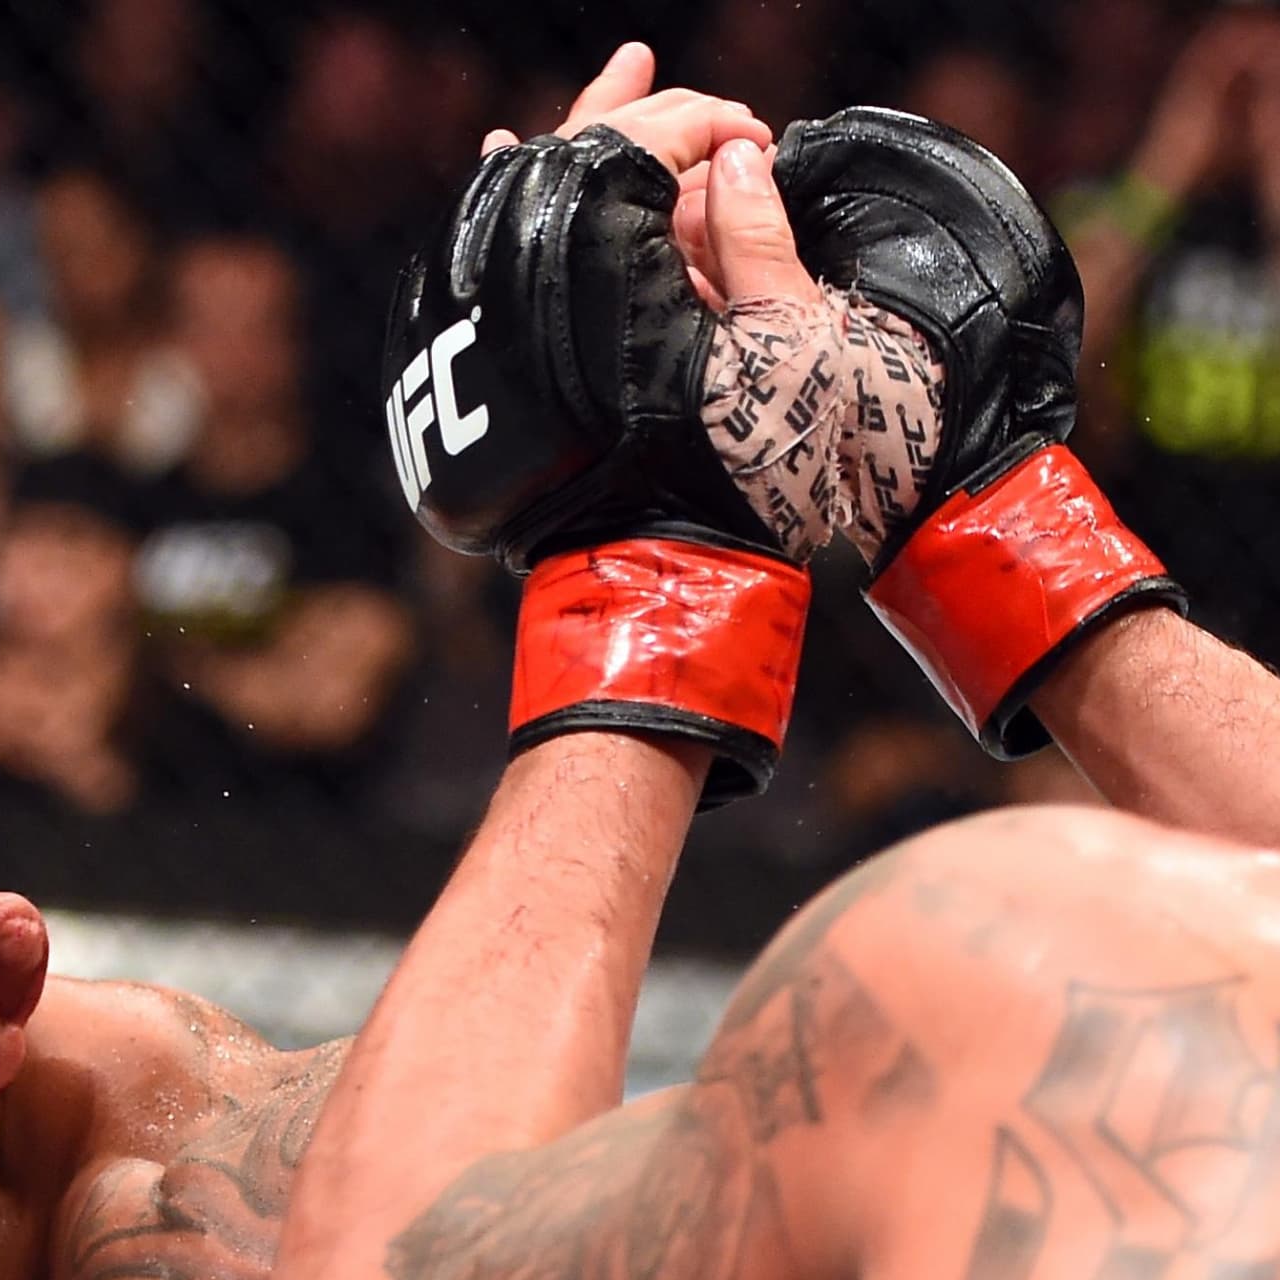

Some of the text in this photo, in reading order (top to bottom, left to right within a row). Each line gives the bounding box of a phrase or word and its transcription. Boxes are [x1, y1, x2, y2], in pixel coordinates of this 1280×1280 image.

[386, 318, 489, 514] UFC
[721, 384, 777, 442] UFC
[784, 351, 836, 436] UFC
